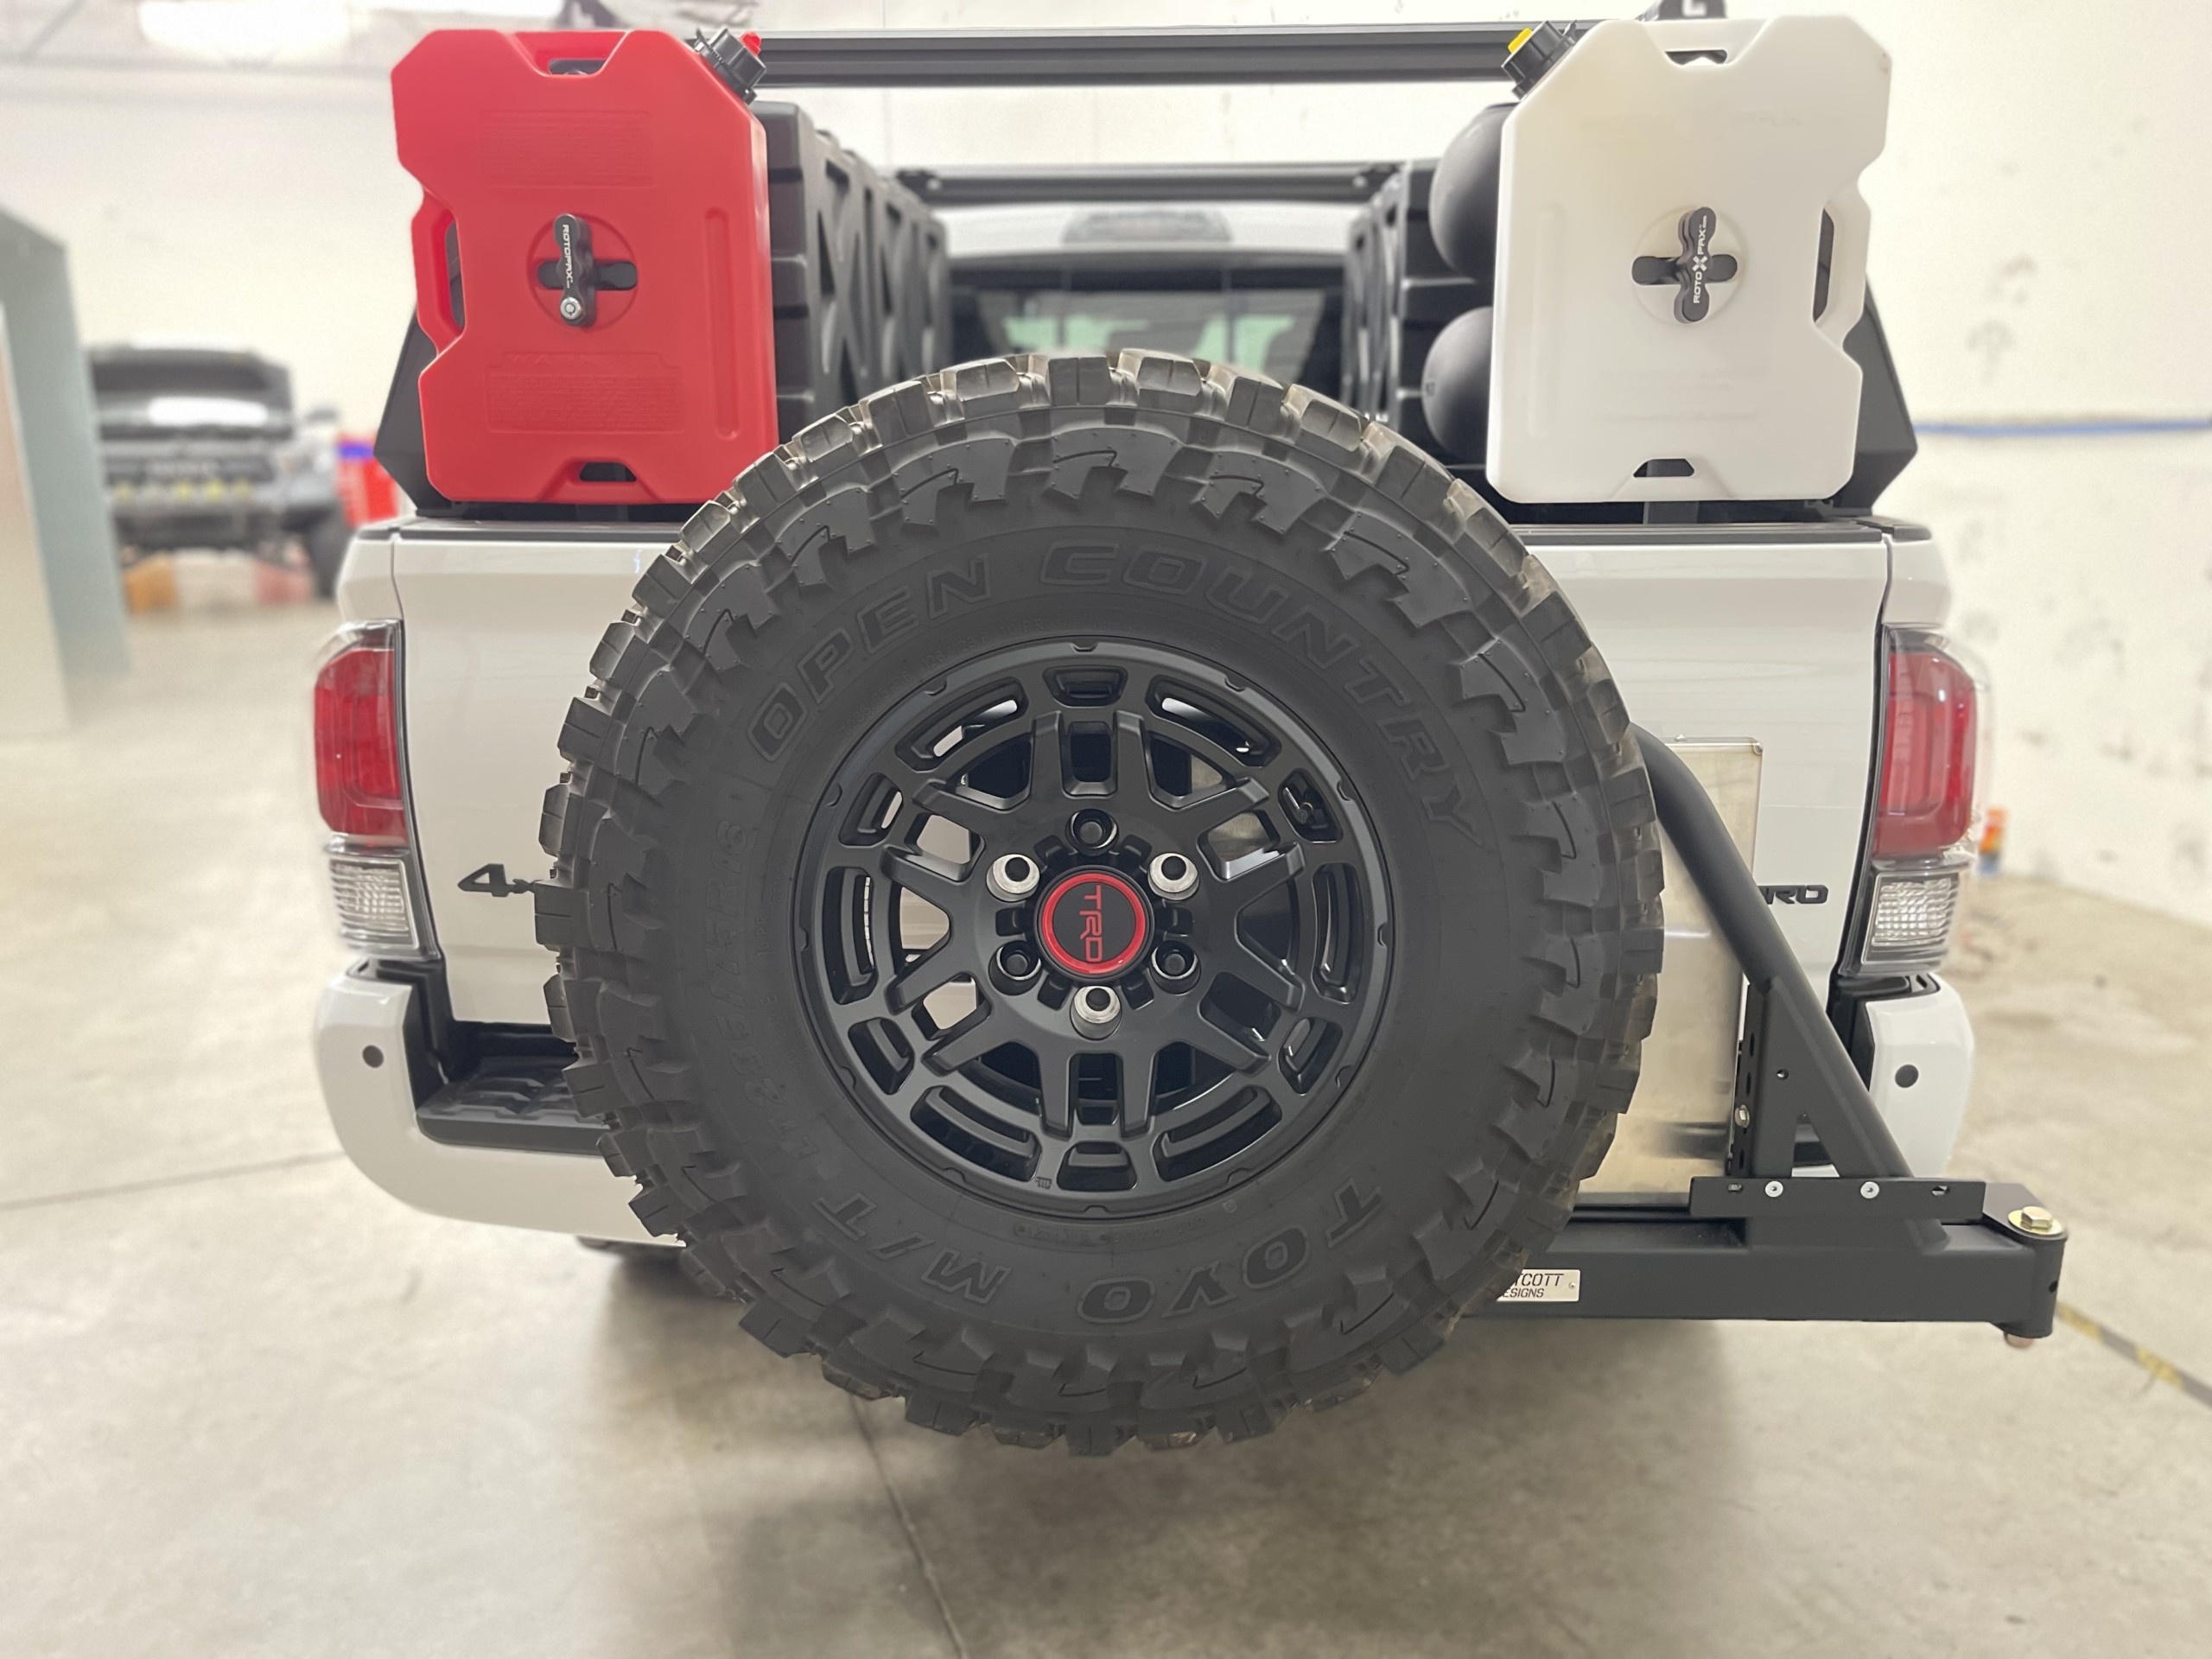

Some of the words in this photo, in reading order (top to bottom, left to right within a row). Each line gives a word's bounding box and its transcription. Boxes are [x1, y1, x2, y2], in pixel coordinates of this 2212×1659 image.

[748, 555, 995, 762] OPEN
[1041, 543, 1482, 846] COUNTRY
[1078, 884, 1103, 963] TRD
[814, 1192, 1012, 1304] M/T
[1077, 1177, 1382, 1323] TOYO
